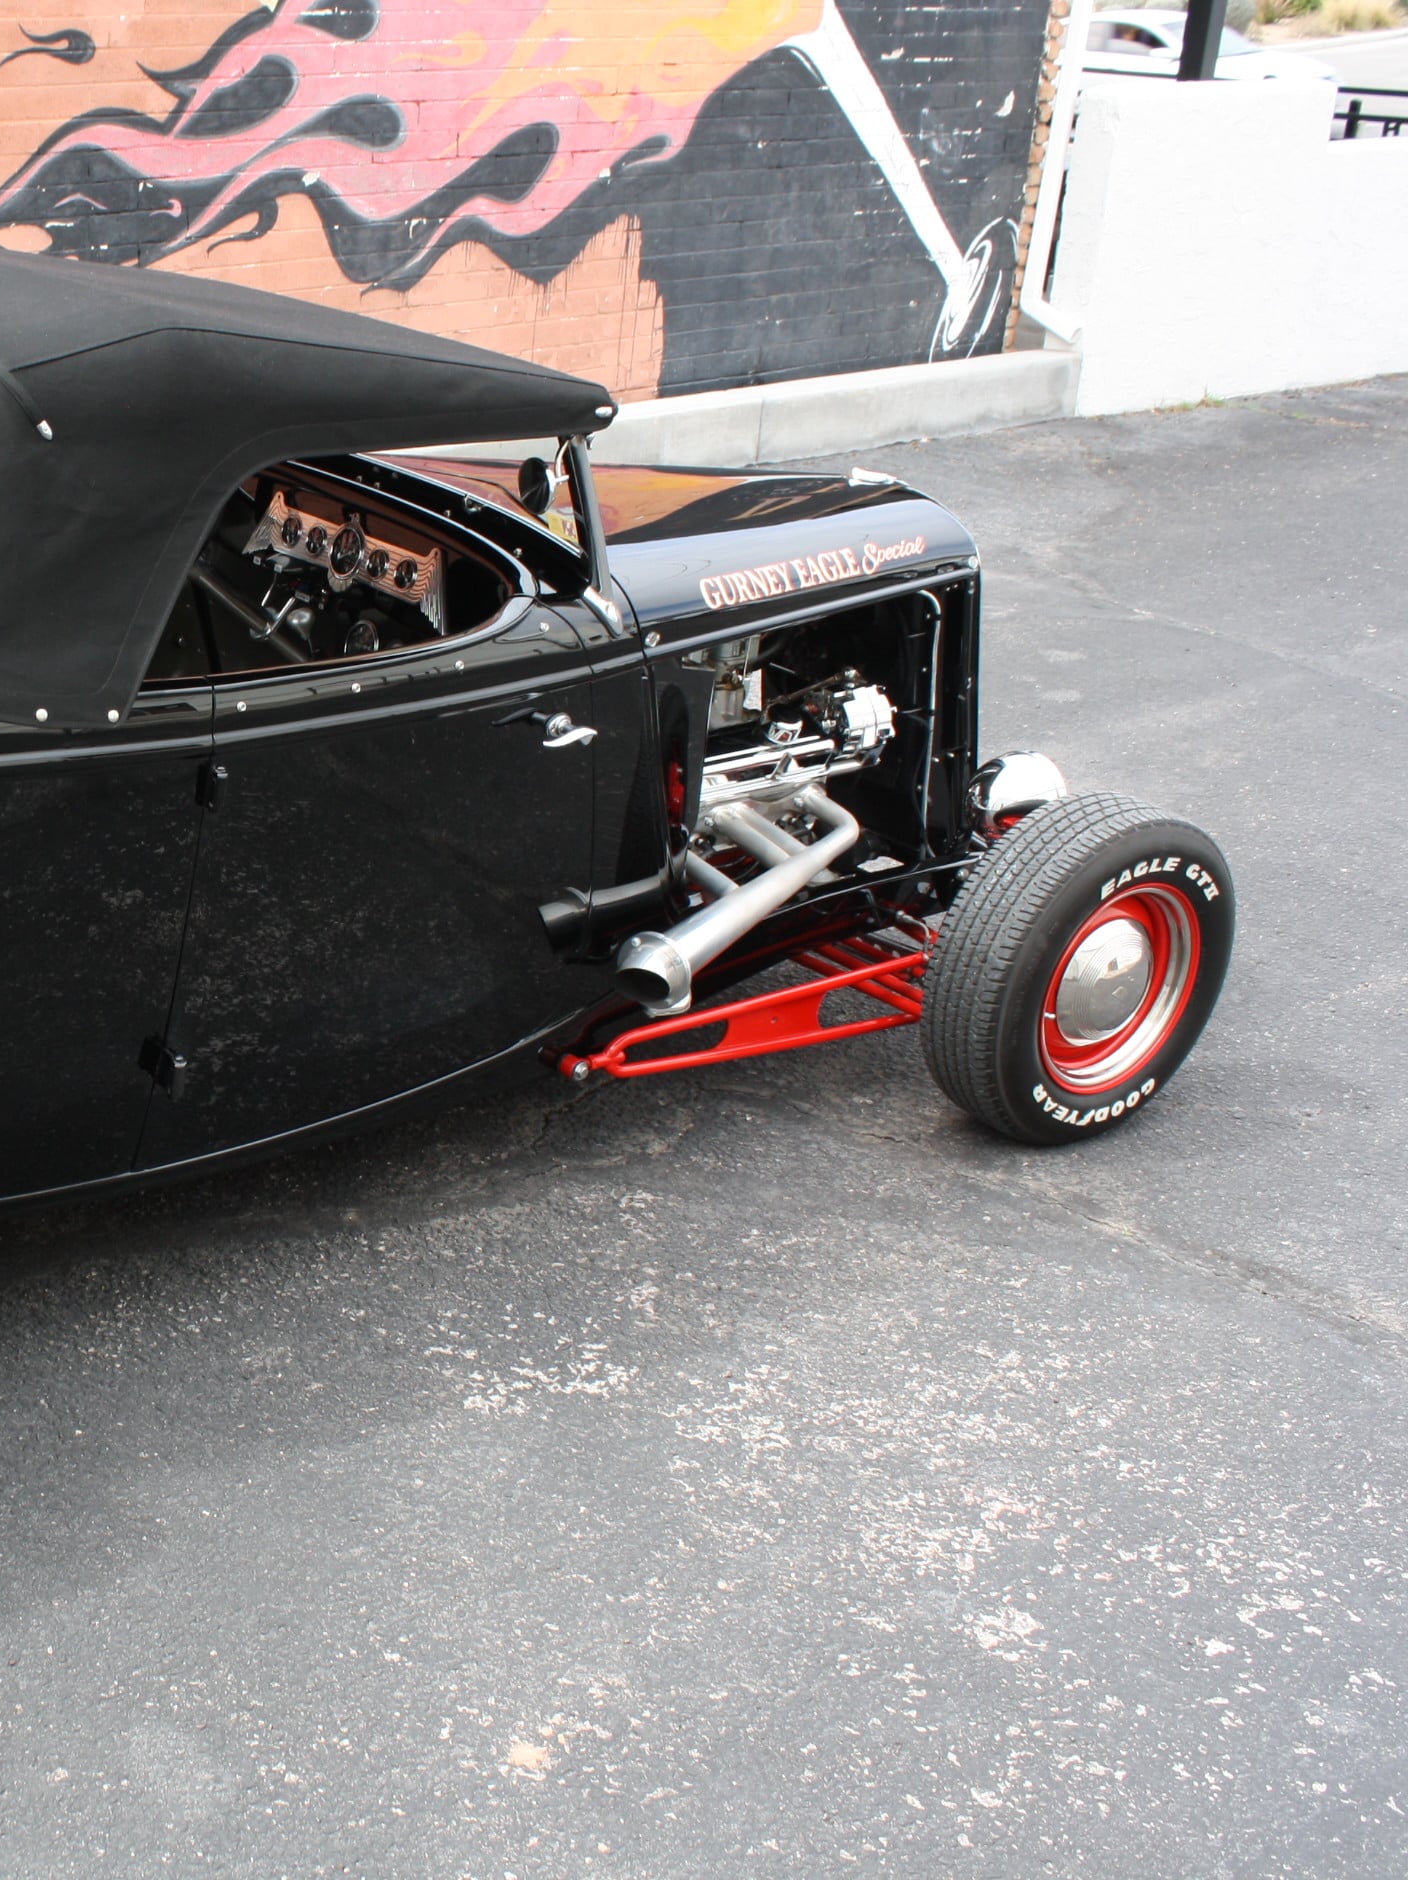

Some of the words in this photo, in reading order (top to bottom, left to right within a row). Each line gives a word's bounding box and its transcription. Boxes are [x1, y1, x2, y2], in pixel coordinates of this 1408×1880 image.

[699, 560, 796, 609] GURNEY
[789, 548, 860, 589] EAGLE
[861, 536, 925, 575] Special
[1100, 856, 1181, 901] EAGLE
[1032, 1078, 1156, 1127] GOODYEAR
